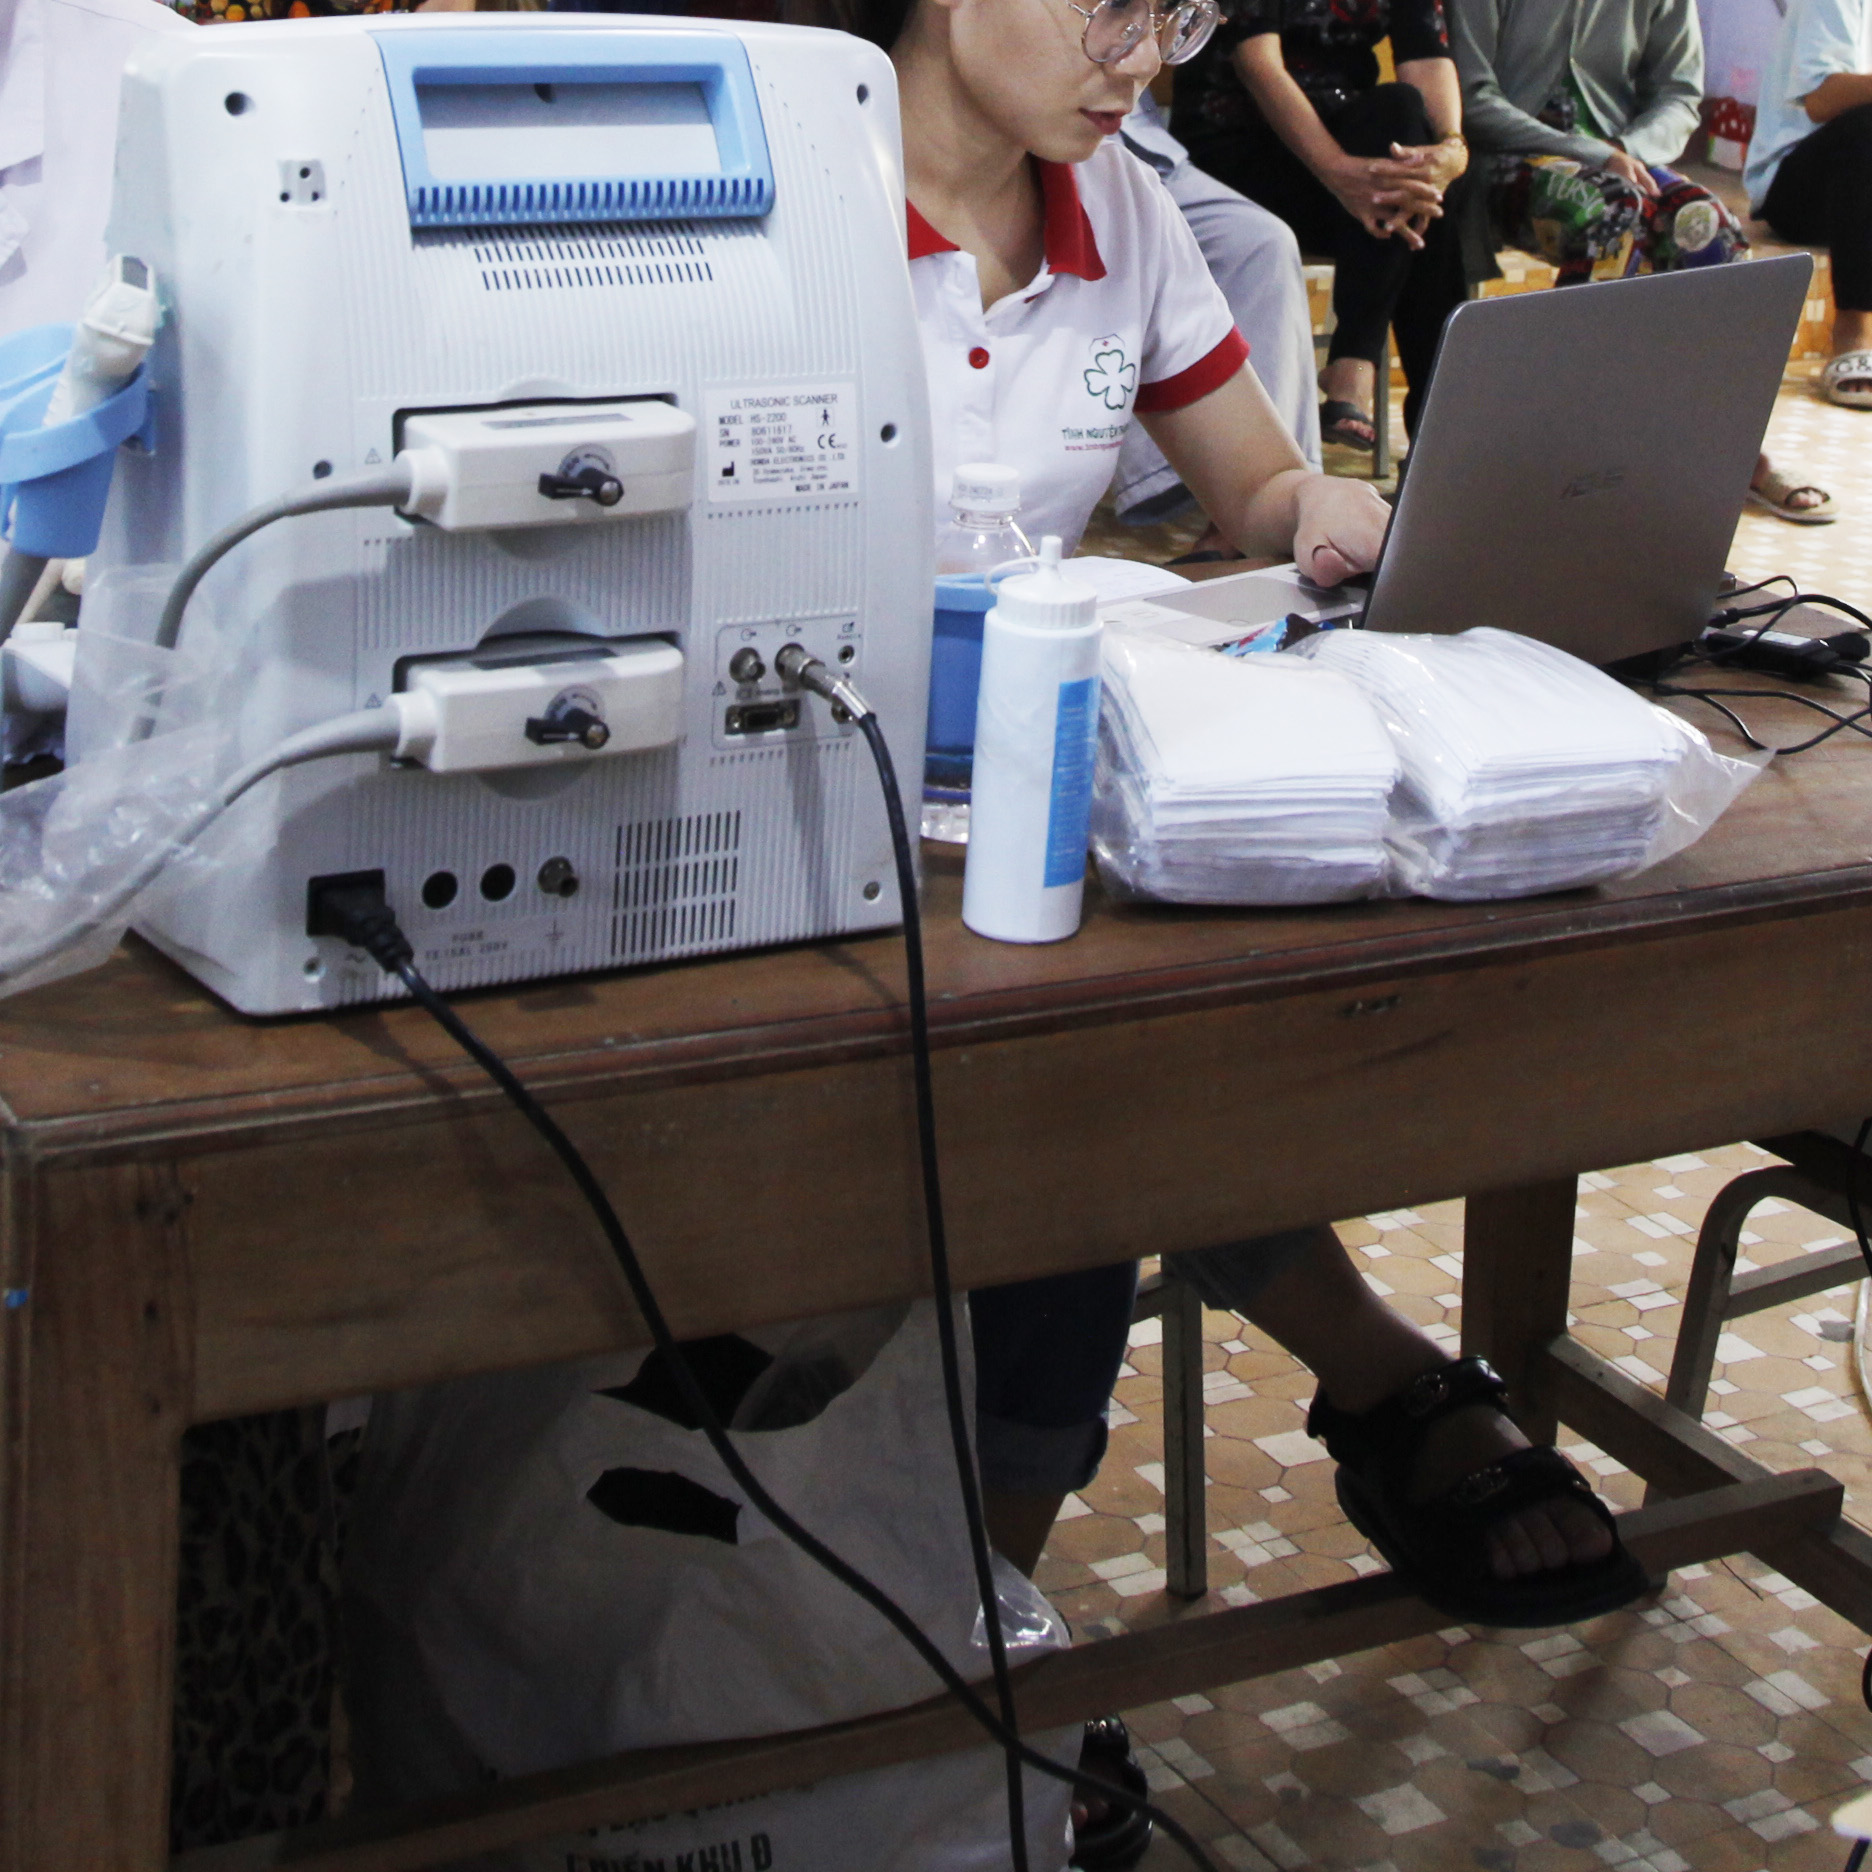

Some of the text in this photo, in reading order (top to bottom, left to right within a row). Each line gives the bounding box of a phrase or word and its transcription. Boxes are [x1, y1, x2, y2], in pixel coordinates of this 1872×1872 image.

[731, 394, 838, 409] ULTRASONIC SCANNER
[719, 415, 743, 425] MODEL
